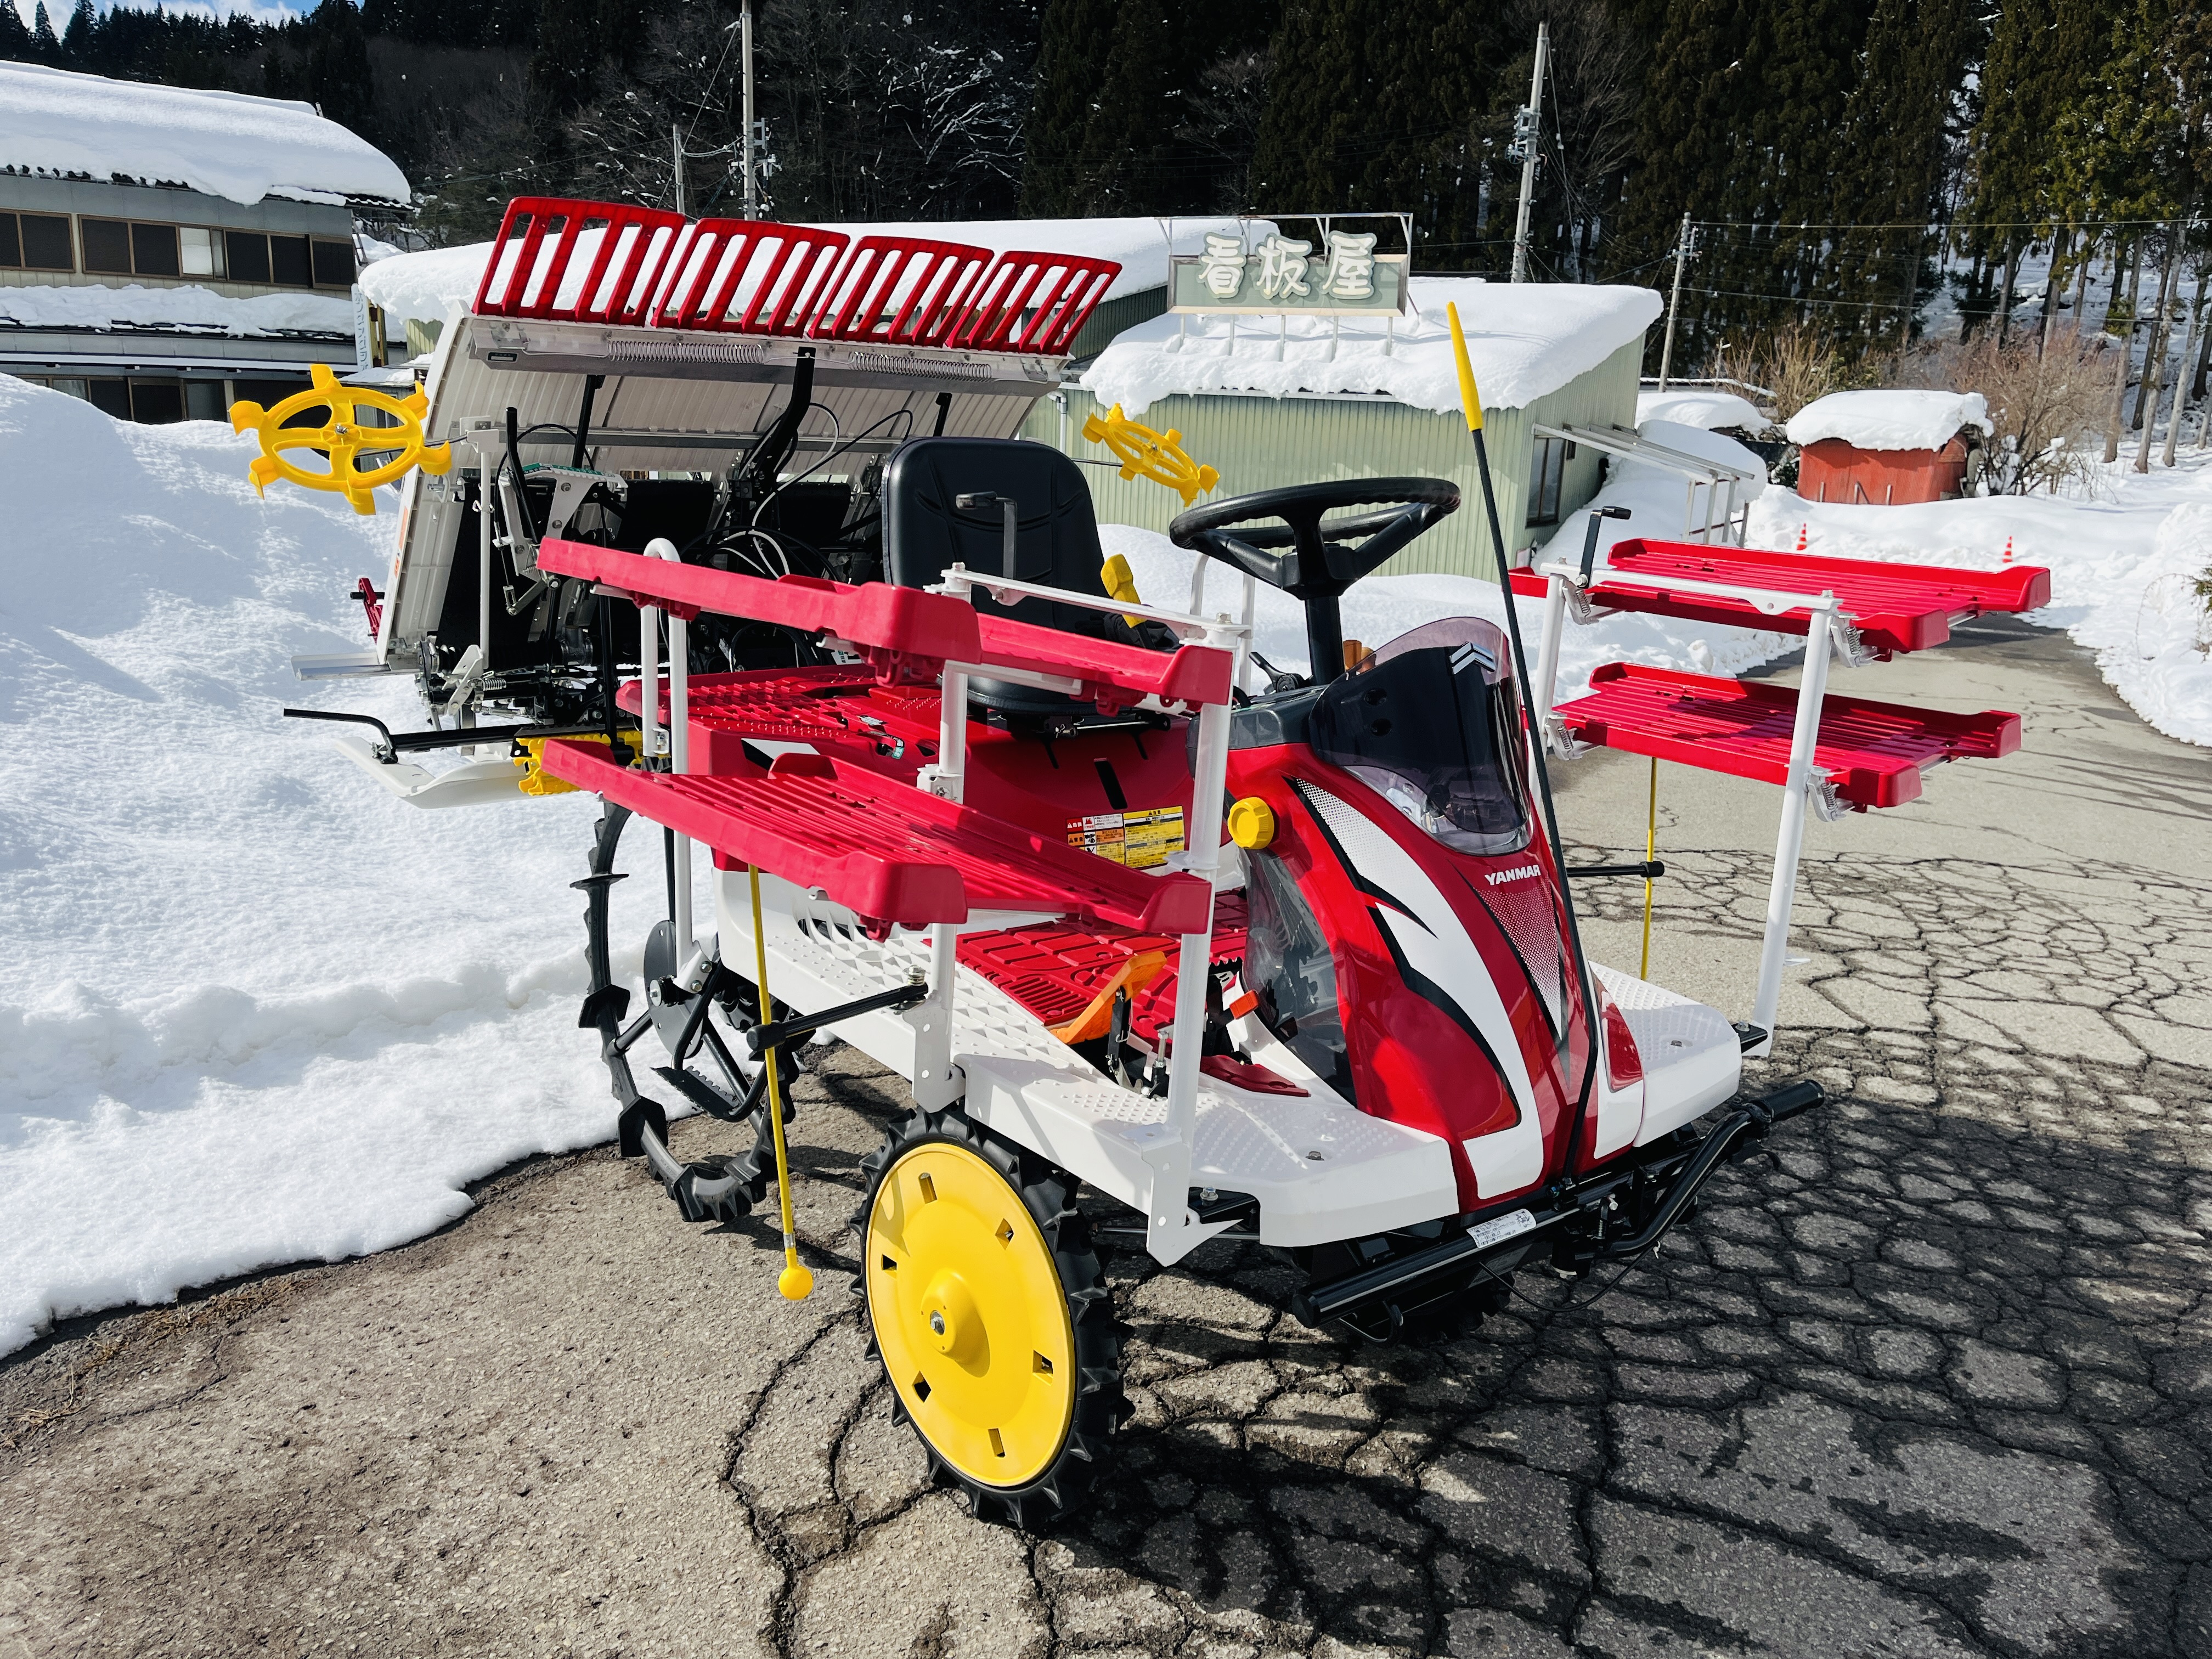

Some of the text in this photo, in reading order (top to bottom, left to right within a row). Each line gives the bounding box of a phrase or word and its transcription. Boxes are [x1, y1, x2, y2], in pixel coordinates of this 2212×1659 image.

[1198, 234, 1374, 296] 看板屋
[1484, 864, 1541, 886] YANMAR
